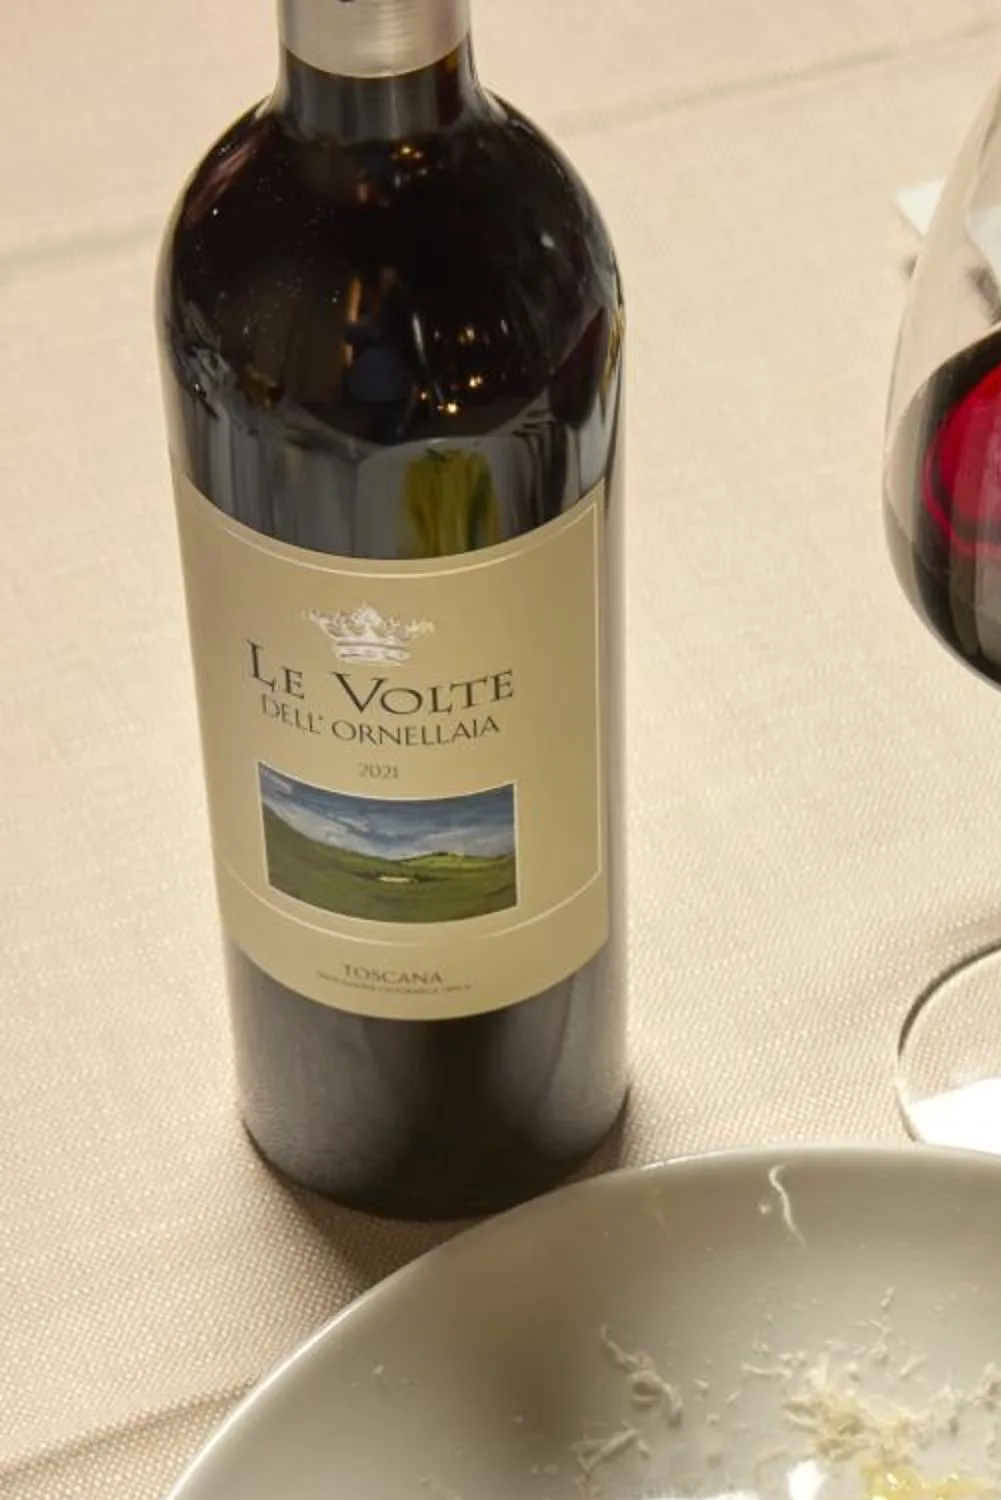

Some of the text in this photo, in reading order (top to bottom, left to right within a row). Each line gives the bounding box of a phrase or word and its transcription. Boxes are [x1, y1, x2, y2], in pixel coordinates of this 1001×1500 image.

[246, 639, 515, 715] LE VOLTE
[358, 762, 399, 780] 2021
[343, 964, 443, 986] TOSCANA
